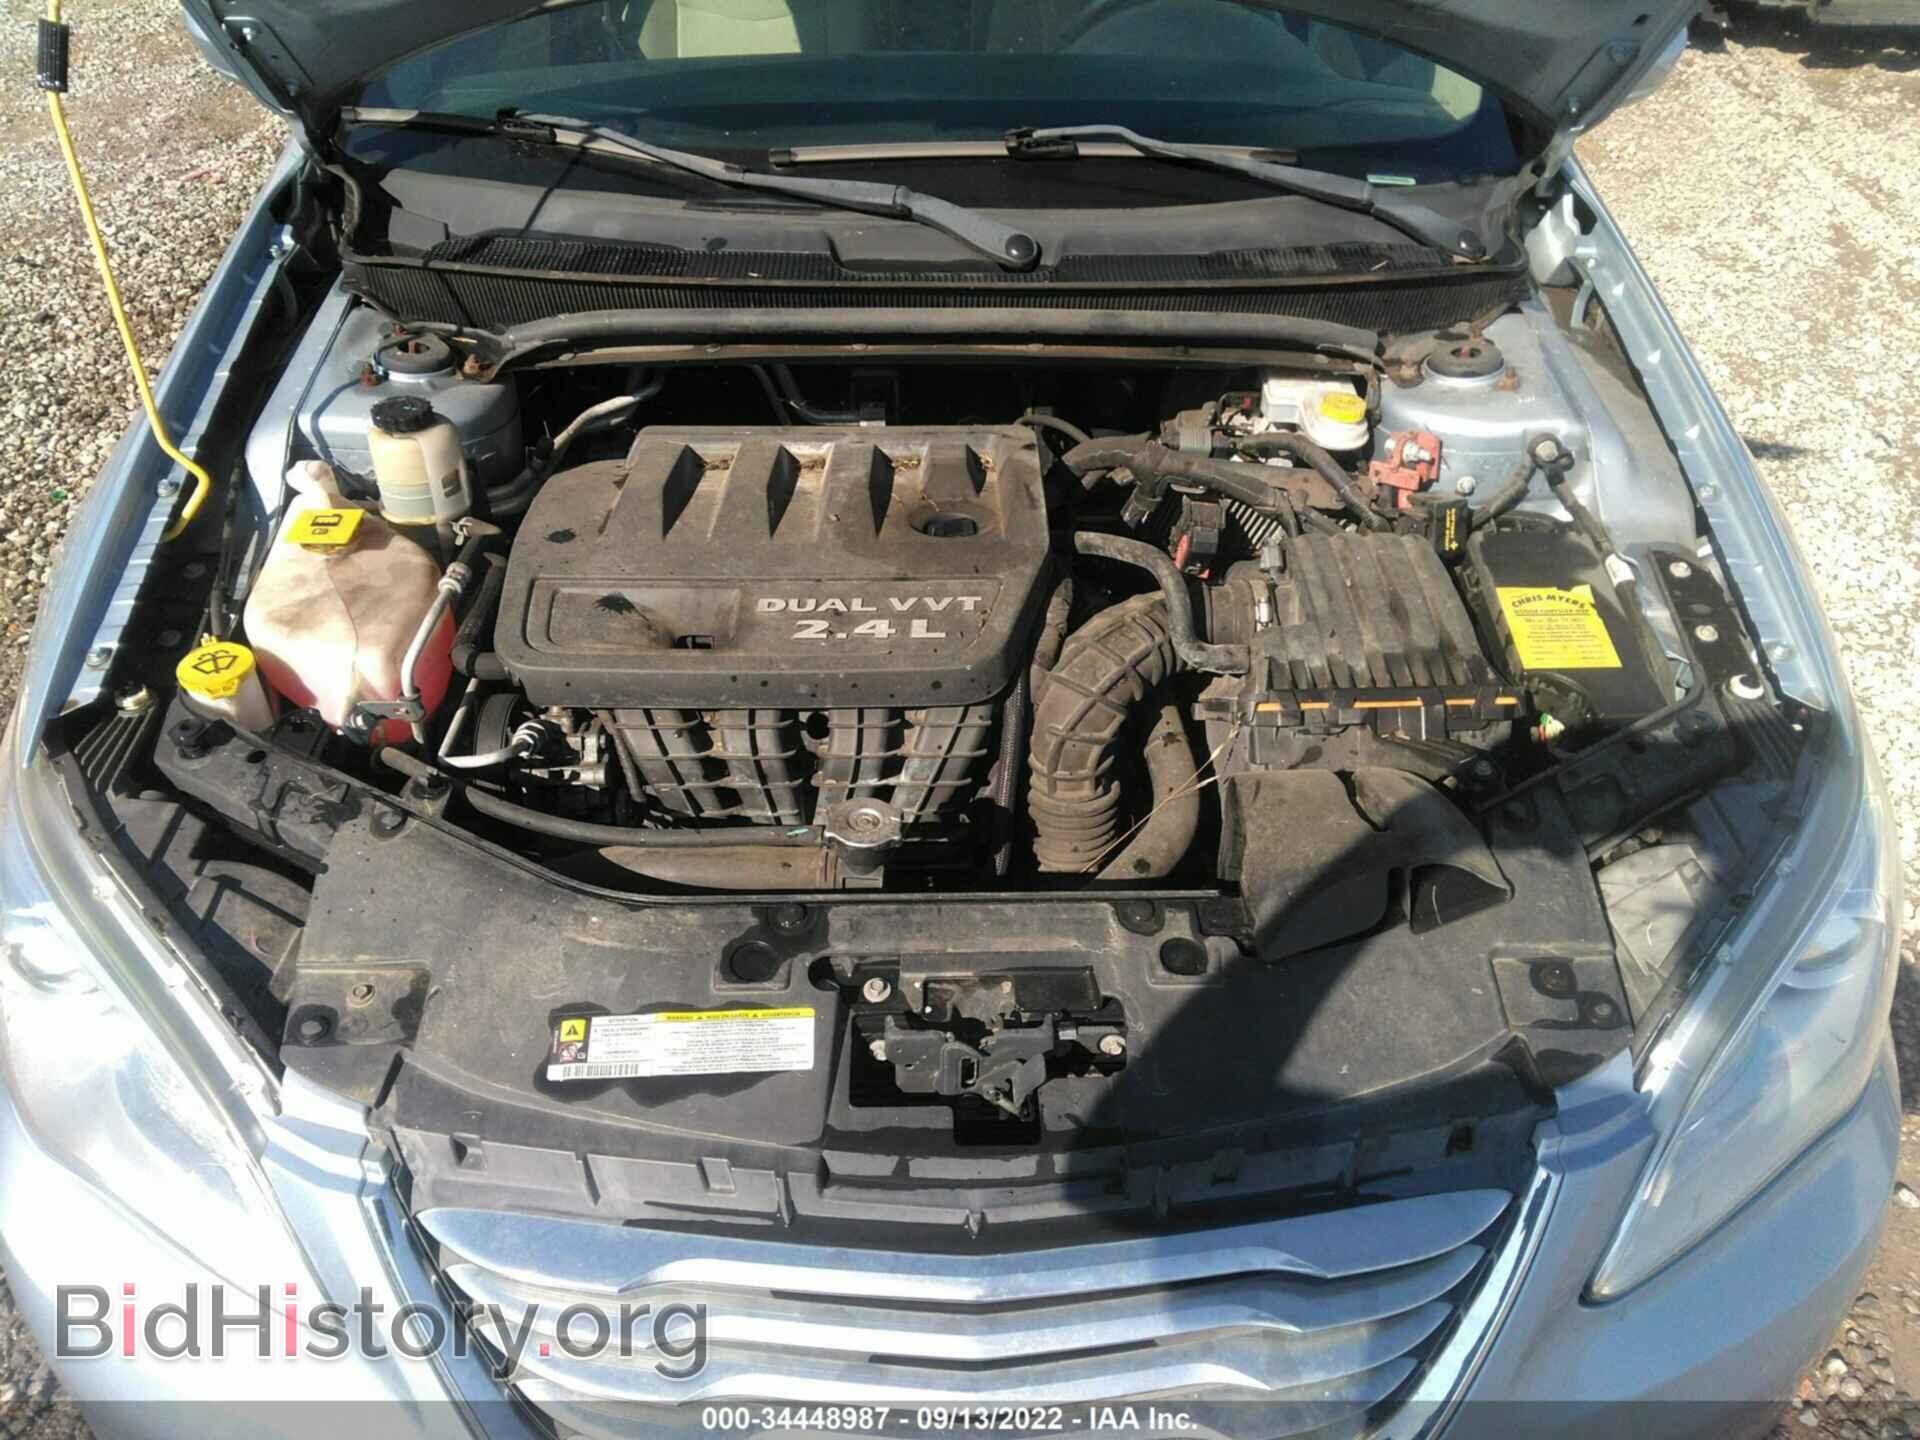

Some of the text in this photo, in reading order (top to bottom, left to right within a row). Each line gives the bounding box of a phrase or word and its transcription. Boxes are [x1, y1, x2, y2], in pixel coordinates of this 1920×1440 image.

[755, 596, 982, 613] DUAL VVT
[1512, 594, 1587, 609] CHRIS MYERS
